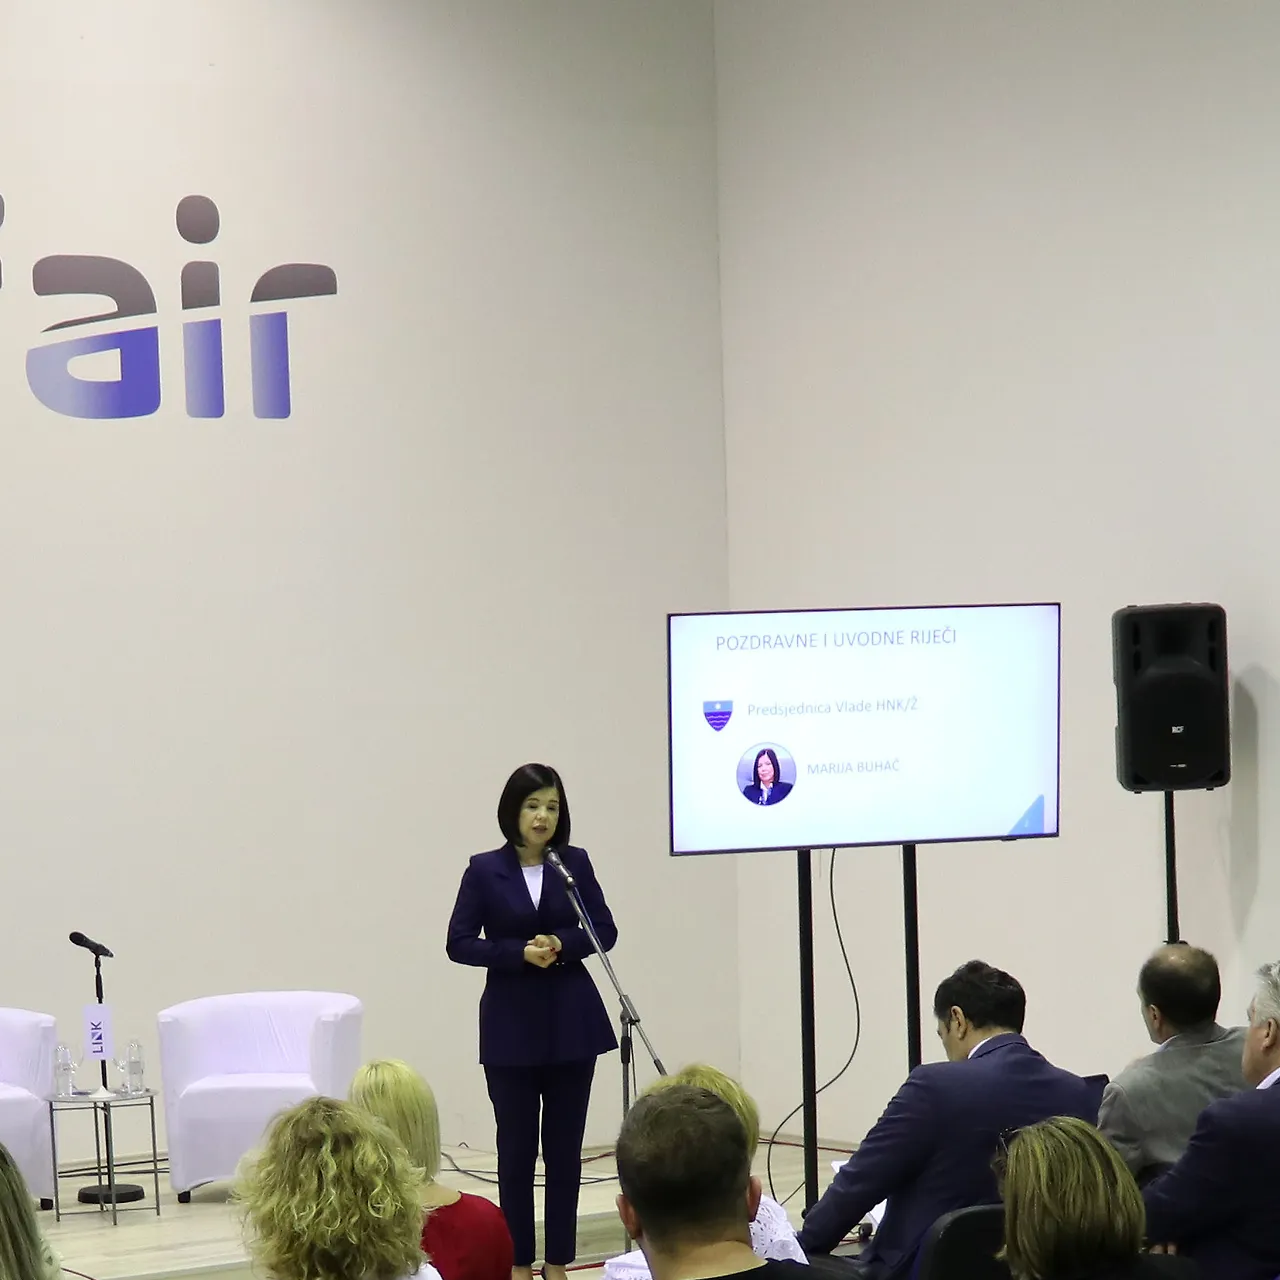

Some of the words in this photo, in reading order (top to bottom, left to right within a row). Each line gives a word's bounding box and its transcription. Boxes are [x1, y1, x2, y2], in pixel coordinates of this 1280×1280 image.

[716, 633, 818, 651] POZDRAVNE
[833, 630, 905, 648] UVODNE
[910, 626, 957, 645] RIJEČI
[747, 701, 831, 718] Predsjednica
[835, 699, 872, 713] Vlade
[806, 763, 853, 776] MARIJA
[90, 1021, 103, 1053] LINK
